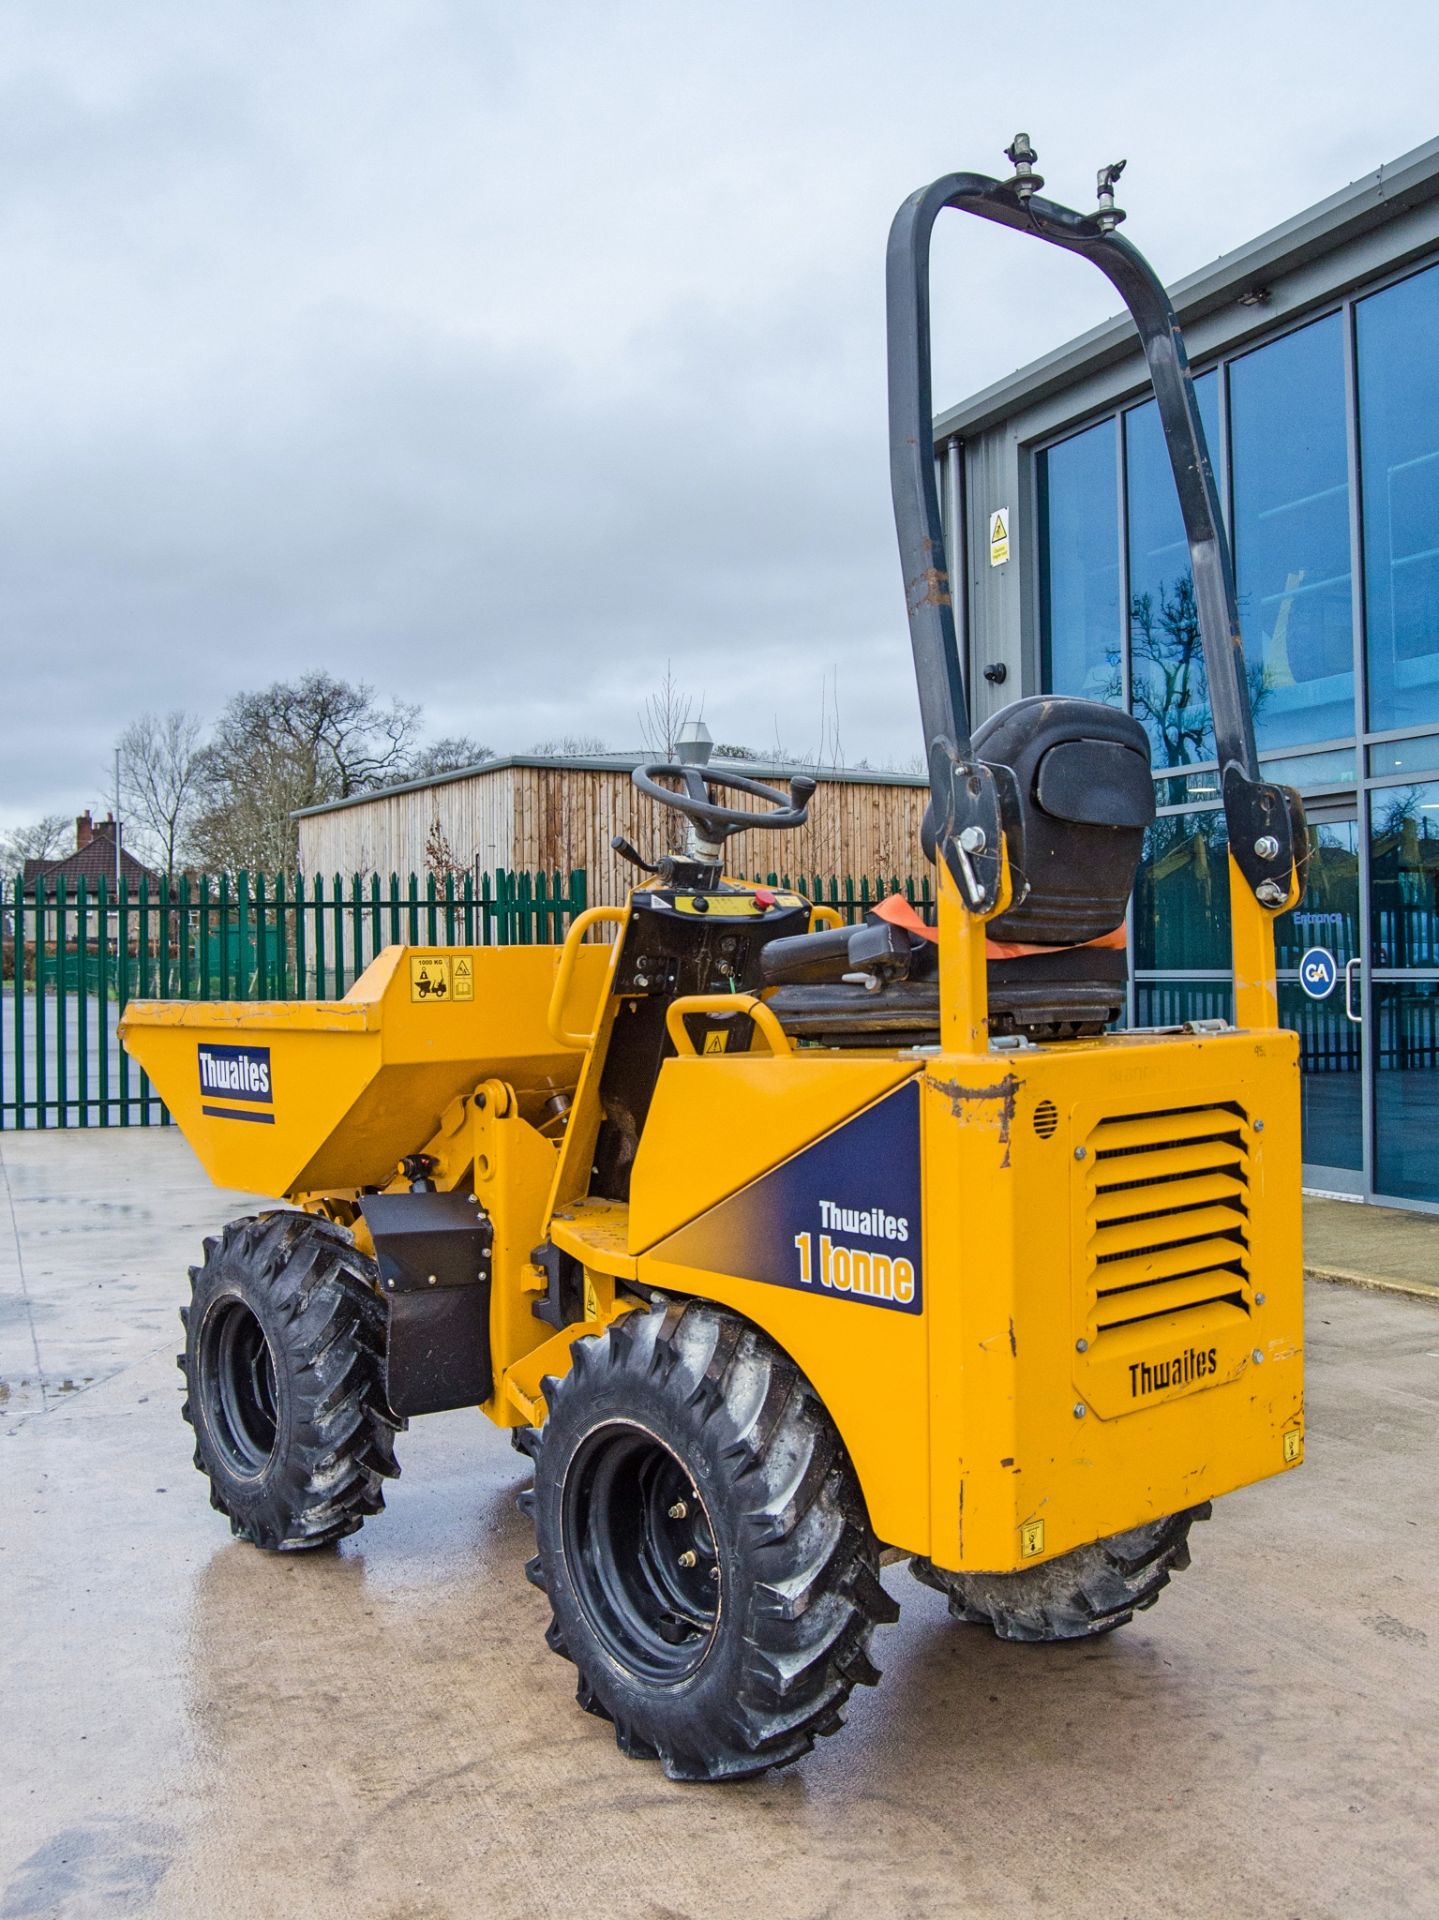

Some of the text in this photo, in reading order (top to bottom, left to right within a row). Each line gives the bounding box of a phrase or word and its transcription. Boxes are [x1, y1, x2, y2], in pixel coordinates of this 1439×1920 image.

[1293, 911, 1343, 925] Entrance
[1305, 963, 1330, 983] GA
[199, 1052, 269, 1093] Thwaites
[819, 1200, 909, 1242] Thwaites
[794, 1231, 915, 1304] 1 tonne
[1129, 1347, 1217, 1398] Thwaites
